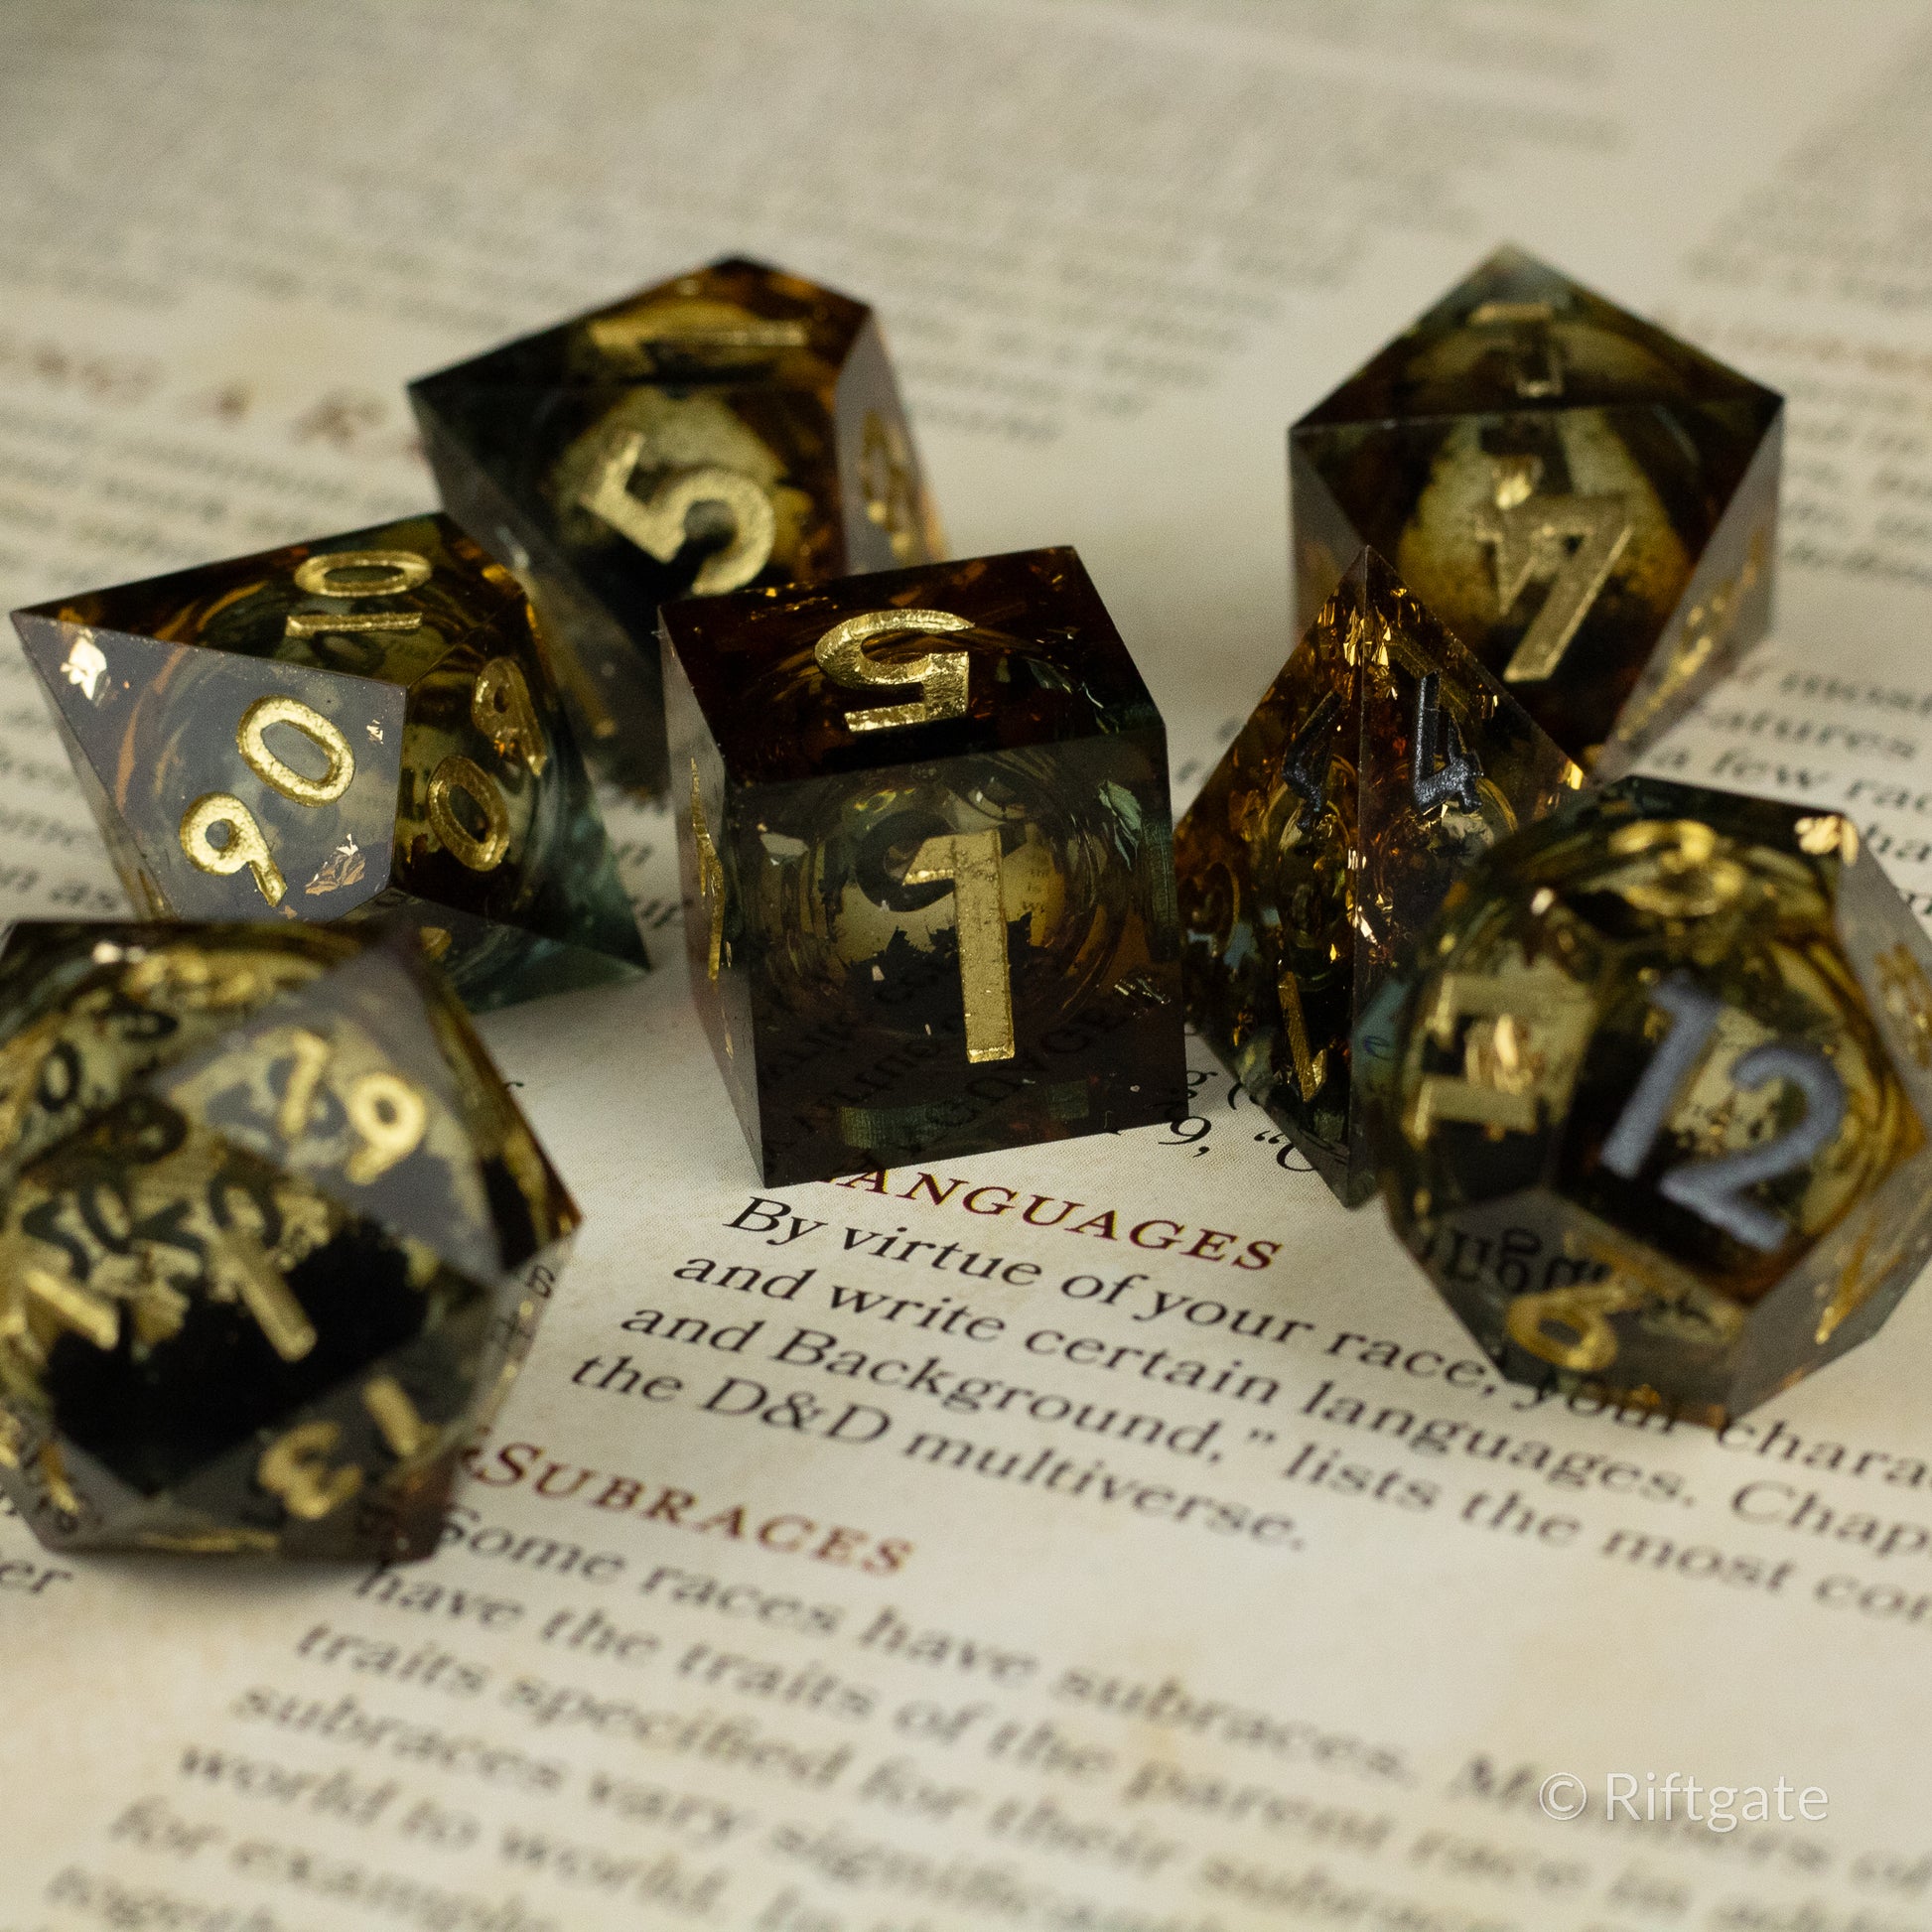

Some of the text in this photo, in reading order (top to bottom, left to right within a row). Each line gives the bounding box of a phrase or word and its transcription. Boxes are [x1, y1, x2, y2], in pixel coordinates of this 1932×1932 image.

[578, 431, 776, 596] 5
[814, 608, 975, 733] 5
[180, 694, 355, 907] 90
[901, 827, 1015, 1064] 1
[1596, 971, 1849, 1251] 12
[826, 1166, 1283, 1273] ANGUAGES
[672, 1256, 817, 1303] and
[828, 1283, 1007, 1344] write
[1023, 1326, 1281, 1406] certain
[1302, 1390, 1698, 1509] languages.
[722, 1196, 828, 1246] By
[841, 1227, 1042, 1287] virtue
[1060, 1271, 1149, 1307] of
[1135, 1281, 1314, 1344] your
[1324, 1328, 1497, 1398] race,
[1716, 1418, 1932, 1489] chara
[473, 1440, 917, 1577] SUBRACES
[569, 1354, 1309, 1553] the D&D multiverse.
[621, 1307, 766, 1354] and
[1284, 1444, 1440, 1513] lists
[1459, 1489, 1586, 1549] the
[1600, 1525, 1799, 1595] most
[295, 1620, 494, 1696] traits
[353, 1557, 528, 1634] have
[539, 1604, 665, 1668] the
[673, 1638, 880, 1723] traits
[443, 1501, 627, 1587] Some
[639, 1561, 846, 1638] races
[856, 1602, 1040, 1684] have
